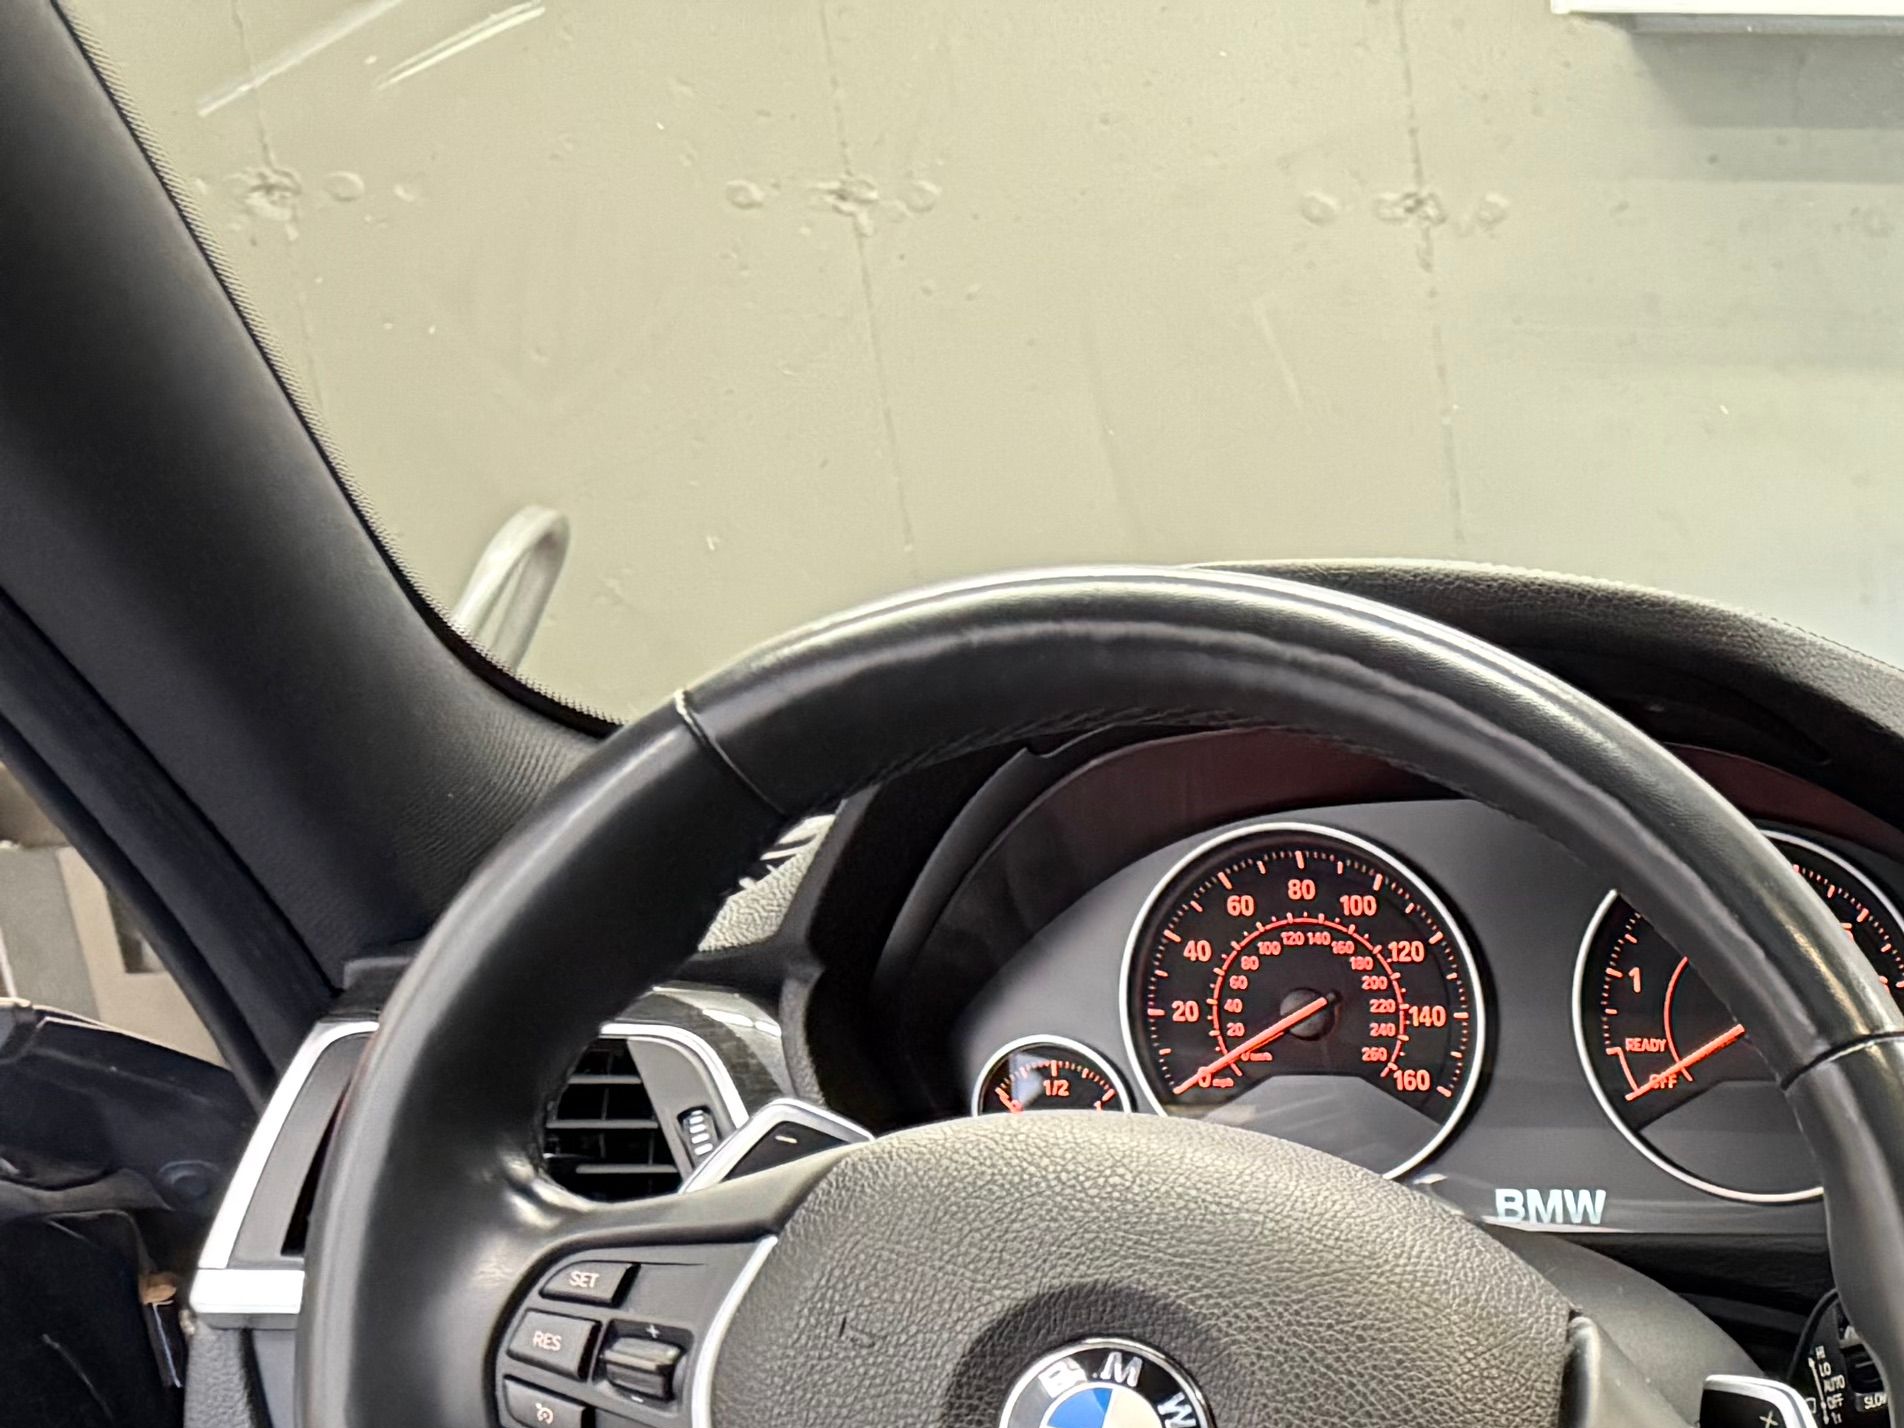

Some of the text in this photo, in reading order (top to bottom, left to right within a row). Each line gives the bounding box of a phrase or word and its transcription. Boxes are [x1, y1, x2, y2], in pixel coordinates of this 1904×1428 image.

[1287, 879, 1316, 900] 80
[1226, 895, 1254, 917] 60
[1340, 895, 1377, 916] 100
[1280, 931, 1305, 946] 120
[1307, 931, 1331, 946] 140
[1184, 940, 1211, 962] 40
[1257, 941, 1281, 956] 100
[1388, 940, 1425, 963] 120
[1361, 976, 1388, 990] 200
[1628, 967, 1641, 993] 1
[1172, 1001, 1199, 1022] 20
[1224, 999, 1242, 1013] 40
[1369, 999, 1395, 1013] 220
[1409, 1005, 1446, 1027] 140
[1227, 1023, 1245, 1037] 20
[1369, 1023, 1395, 1037] 240
[1625, 1037, 1667, 1052] READY
[1043, 1079, 1070, 1097] 1/2
[1394, 1070, 1431, 1091] 160
[1495, 1188, 1606, 1224] BMW
[569, 1271, 600, 1288] SET
[532, 1331, 562, 1351] RES
